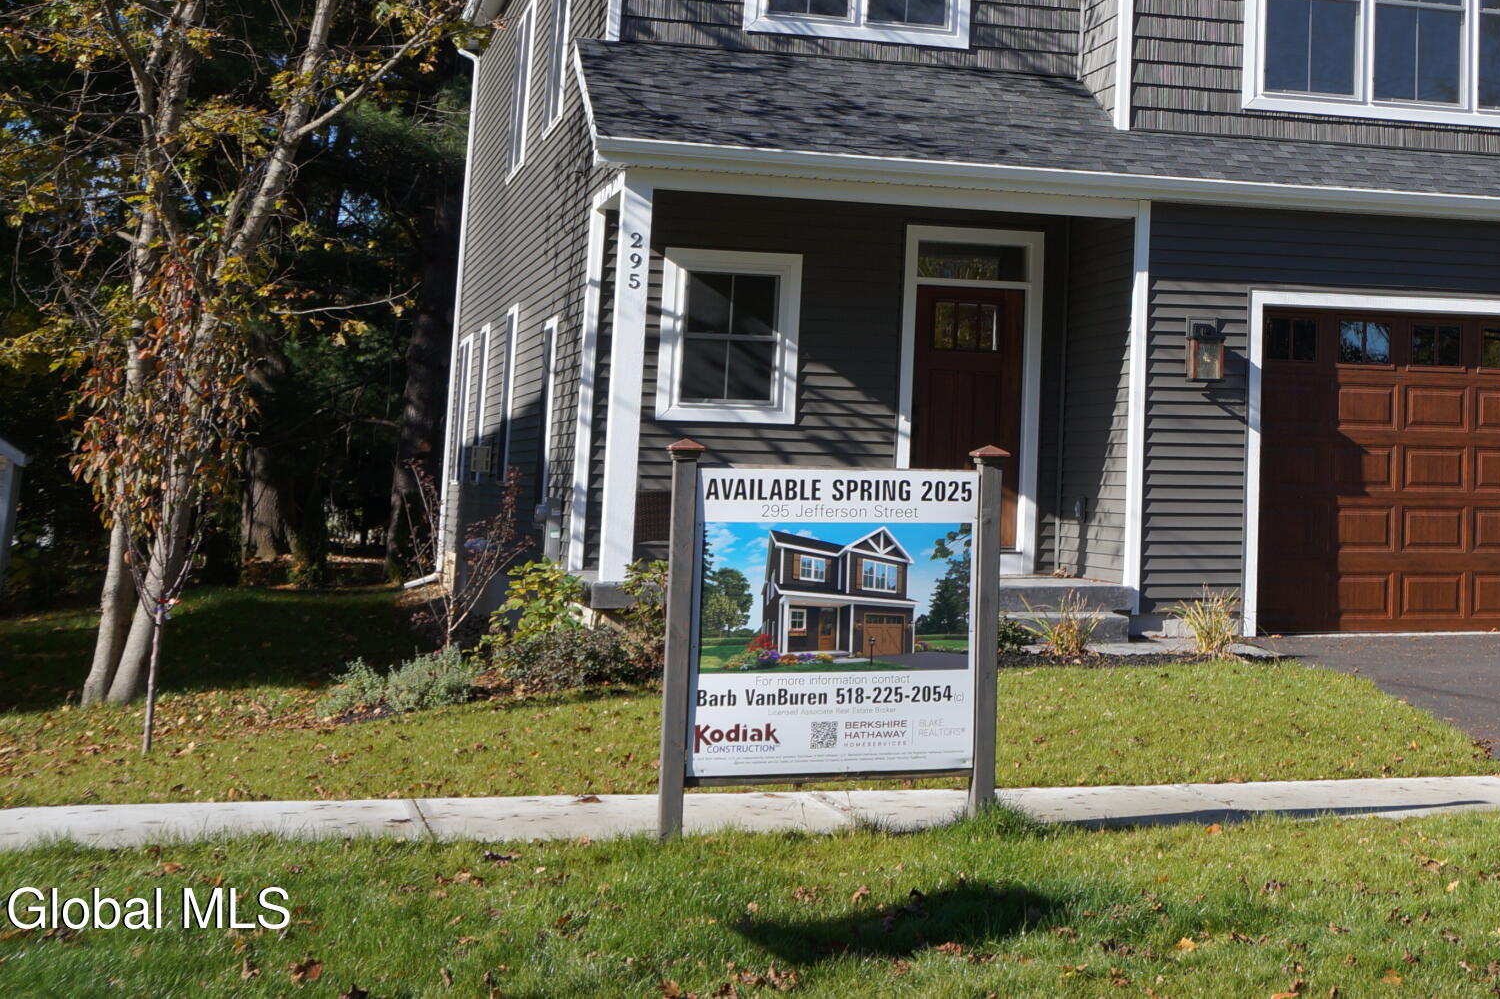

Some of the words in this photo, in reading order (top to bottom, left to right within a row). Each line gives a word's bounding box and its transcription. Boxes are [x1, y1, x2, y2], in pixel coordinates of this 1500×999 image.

[628, 232, 643, 289] 295
[705, 478, 822, 501] AVAILABLE
[831, 478, 912, 502] SPRING
[920, 480, 973, 502] 2025
[761, 504, 790, 518] 295
[795, 504, 867, 518] Jefferson
[874, 504, 919, 519] Street
[755, 675, 773, 686] For
[777, 676, 805, 686] more
[809, 674, 868, 686] information
[871, 673, 911, 684] contact
[696, 689, 737, 707] Barb
[745, 688, 828, 707] VanBuren
[836, 685, 953, 705] 518-225-2054
[844, 719, 908, 730] BERKSHIRE
[694, 723, 781, 754] Kodiak
[844, 730, 907, 739] HATHAWAY
[706, 744, 775, 754] CONSTRUCTION
